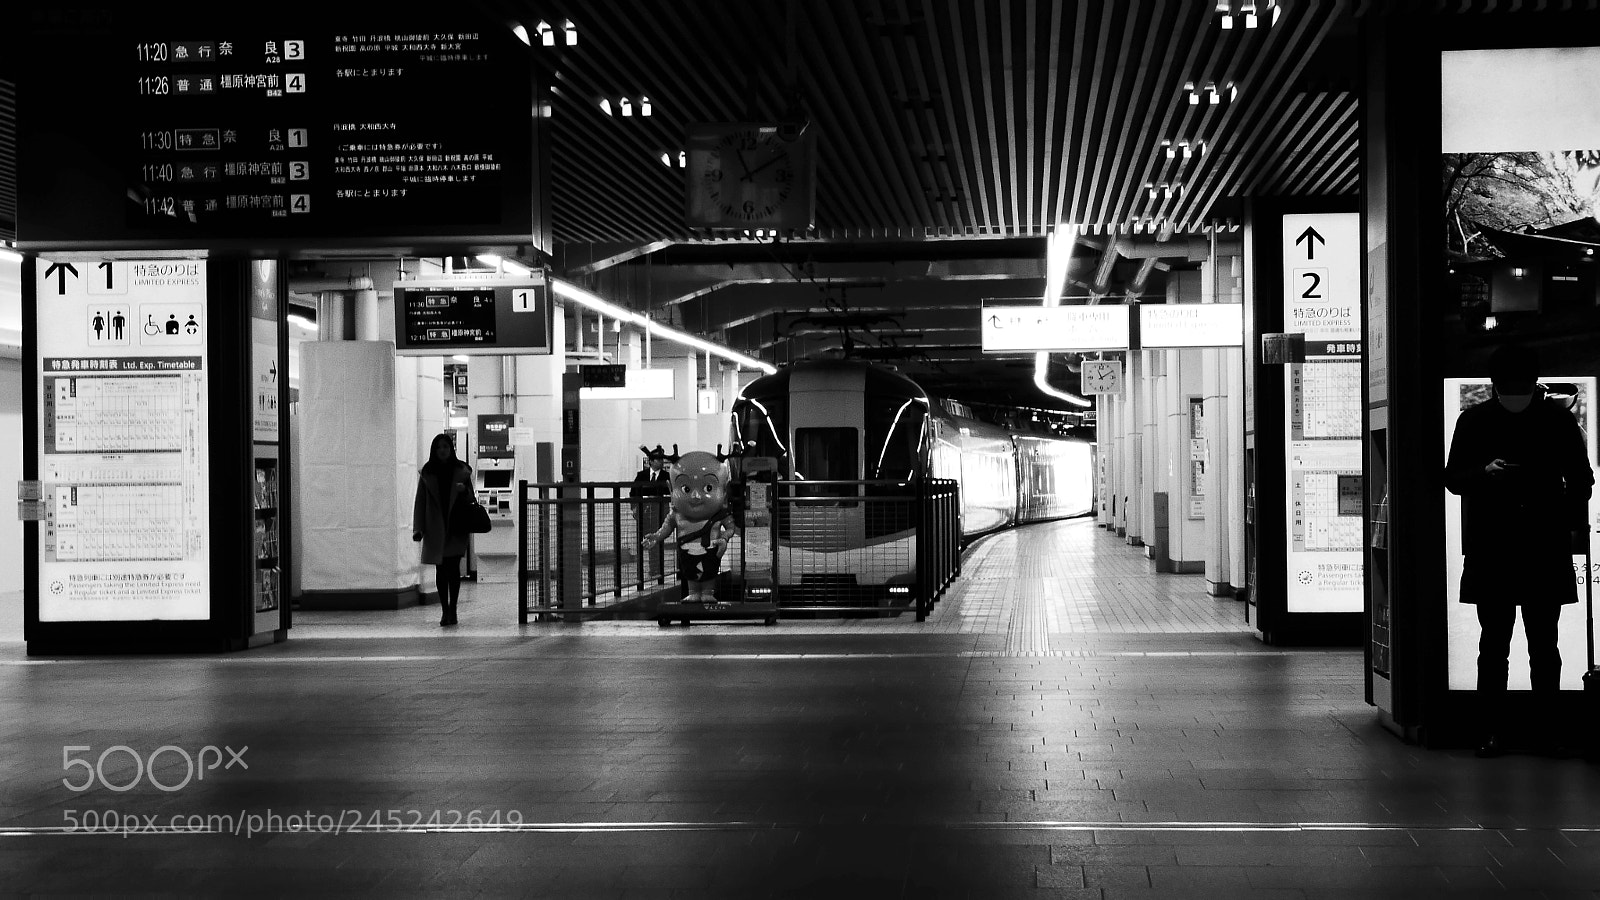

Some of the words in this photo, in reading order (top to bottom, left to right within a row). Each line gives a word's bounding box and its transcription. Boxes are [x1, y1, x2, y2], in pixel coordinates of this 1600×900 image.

[433, 33, 454, 41] 大久保
[137, 43, 167, 61] 11:20
[288, 42, 300, 58] 3
[336, 68, 403, 77] 各駅にとまります
[138, 76, 168, 95] 11:26
[220, 74, 279, 88] 橿原神宮前
[289, 76, 302, 91] 4
[141, 131, 171, 149] 11:30
[292, 131, 302, 146] 1
[741, 138, 757, 150] 12
[142, 164, 172, 182] 11:40
[225, 162, 282, 176] 橿原神宮前
[294, 163, 305, 179] 3
[711, 170, 723, 182] 9
[776, 169, 786, 182] 3
[336, 189, 408, 198] 各駅にとまります
[144, 197, 175, 215] 11:42
[226, 195, 284, 209] 橿原神宮前
[294, 196, 307, 211] 4
[743, 201, 754, 213] 6
[98, 262, 113, 289] 1
[134, 263, 199, 277] 特急のりば
[134, 278, 165, 286] LIMITED
[167, 278, 199, 286] EXPRESS
[1302, 273, 1321, 298] 2
[519, 292, 528, 309] 1
[1294, 307, 1351, 318] 特急のりば
[51, 359, 118, 370] 特急発車時刻表
[123, 361, 137, 369] Ltd.
[140, 361, 155, 371] Exp.
[158, 361, 195, 369] Timetable
[704, 396, 711, 409] 1
